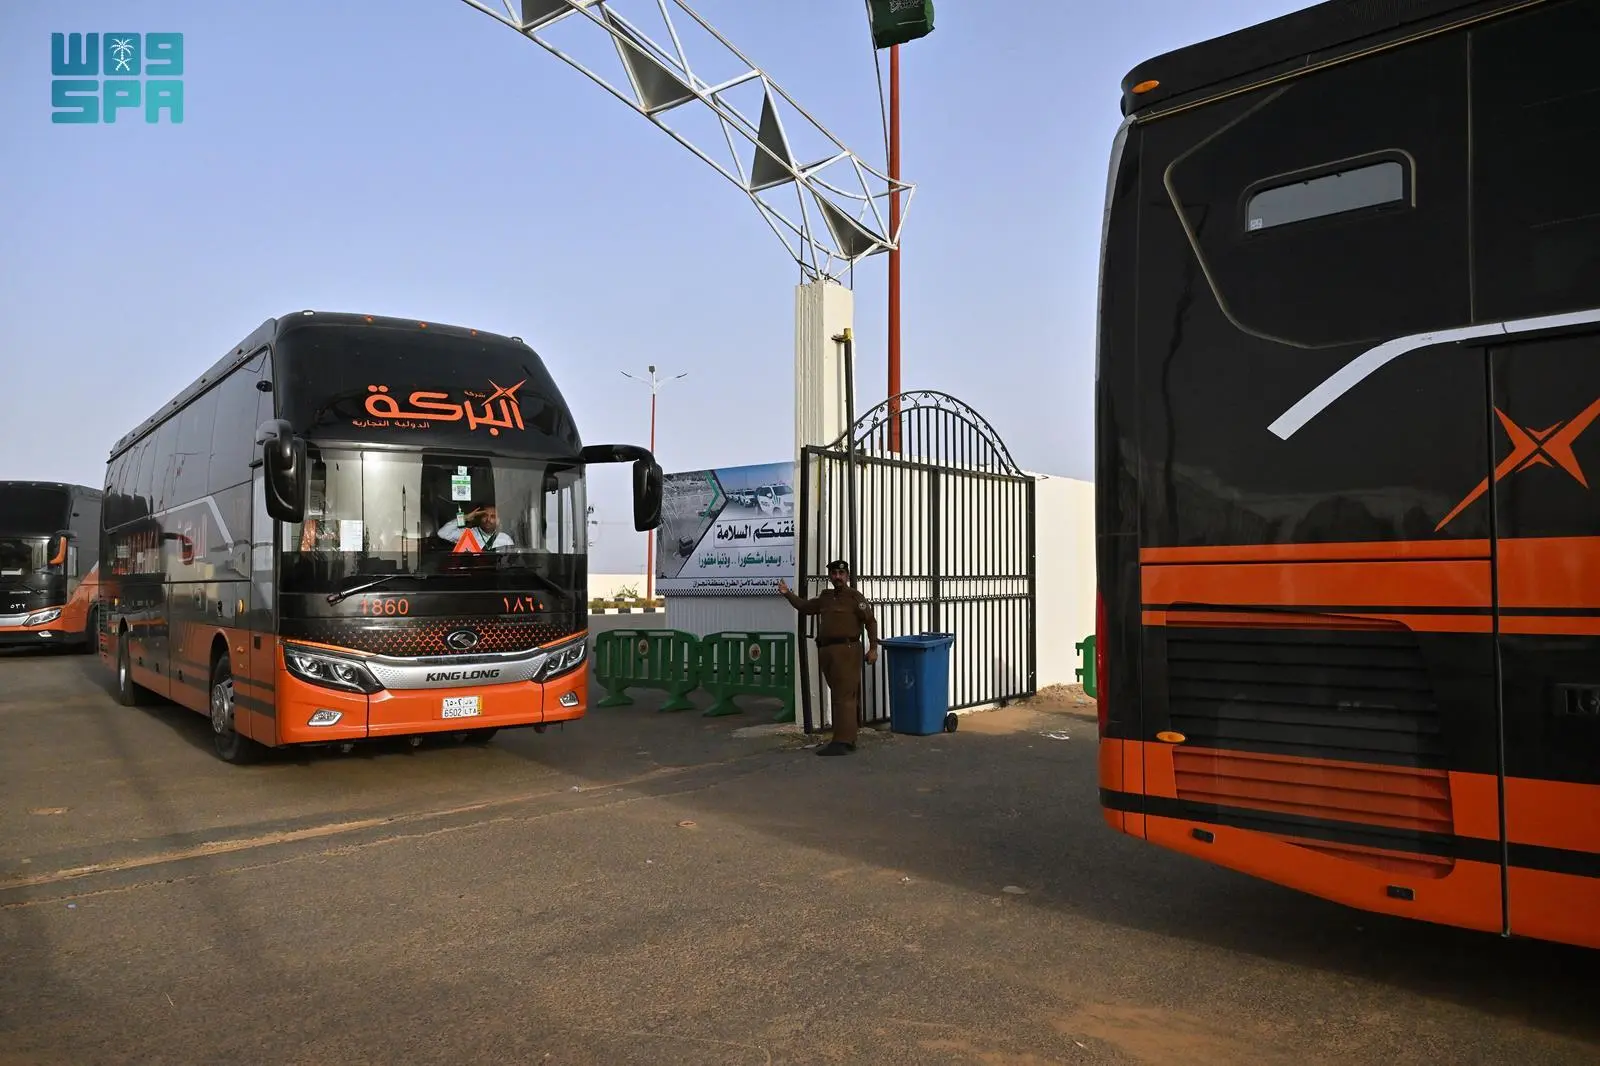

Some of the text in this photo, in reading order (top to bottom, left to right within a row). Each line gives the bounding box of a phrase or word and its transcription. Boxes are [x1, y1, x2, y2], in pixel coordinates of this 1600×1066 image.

[365, 384, 526, 436] البركة
[717, 520, 795, 543] فقتكم السلامة
[361, 598, 409, 616] 1860
[503, 596, 545, 613] ١٨٦٠
[425, 669, 500, 682] KING LONG
[444, 708, 462, 718] 6502
